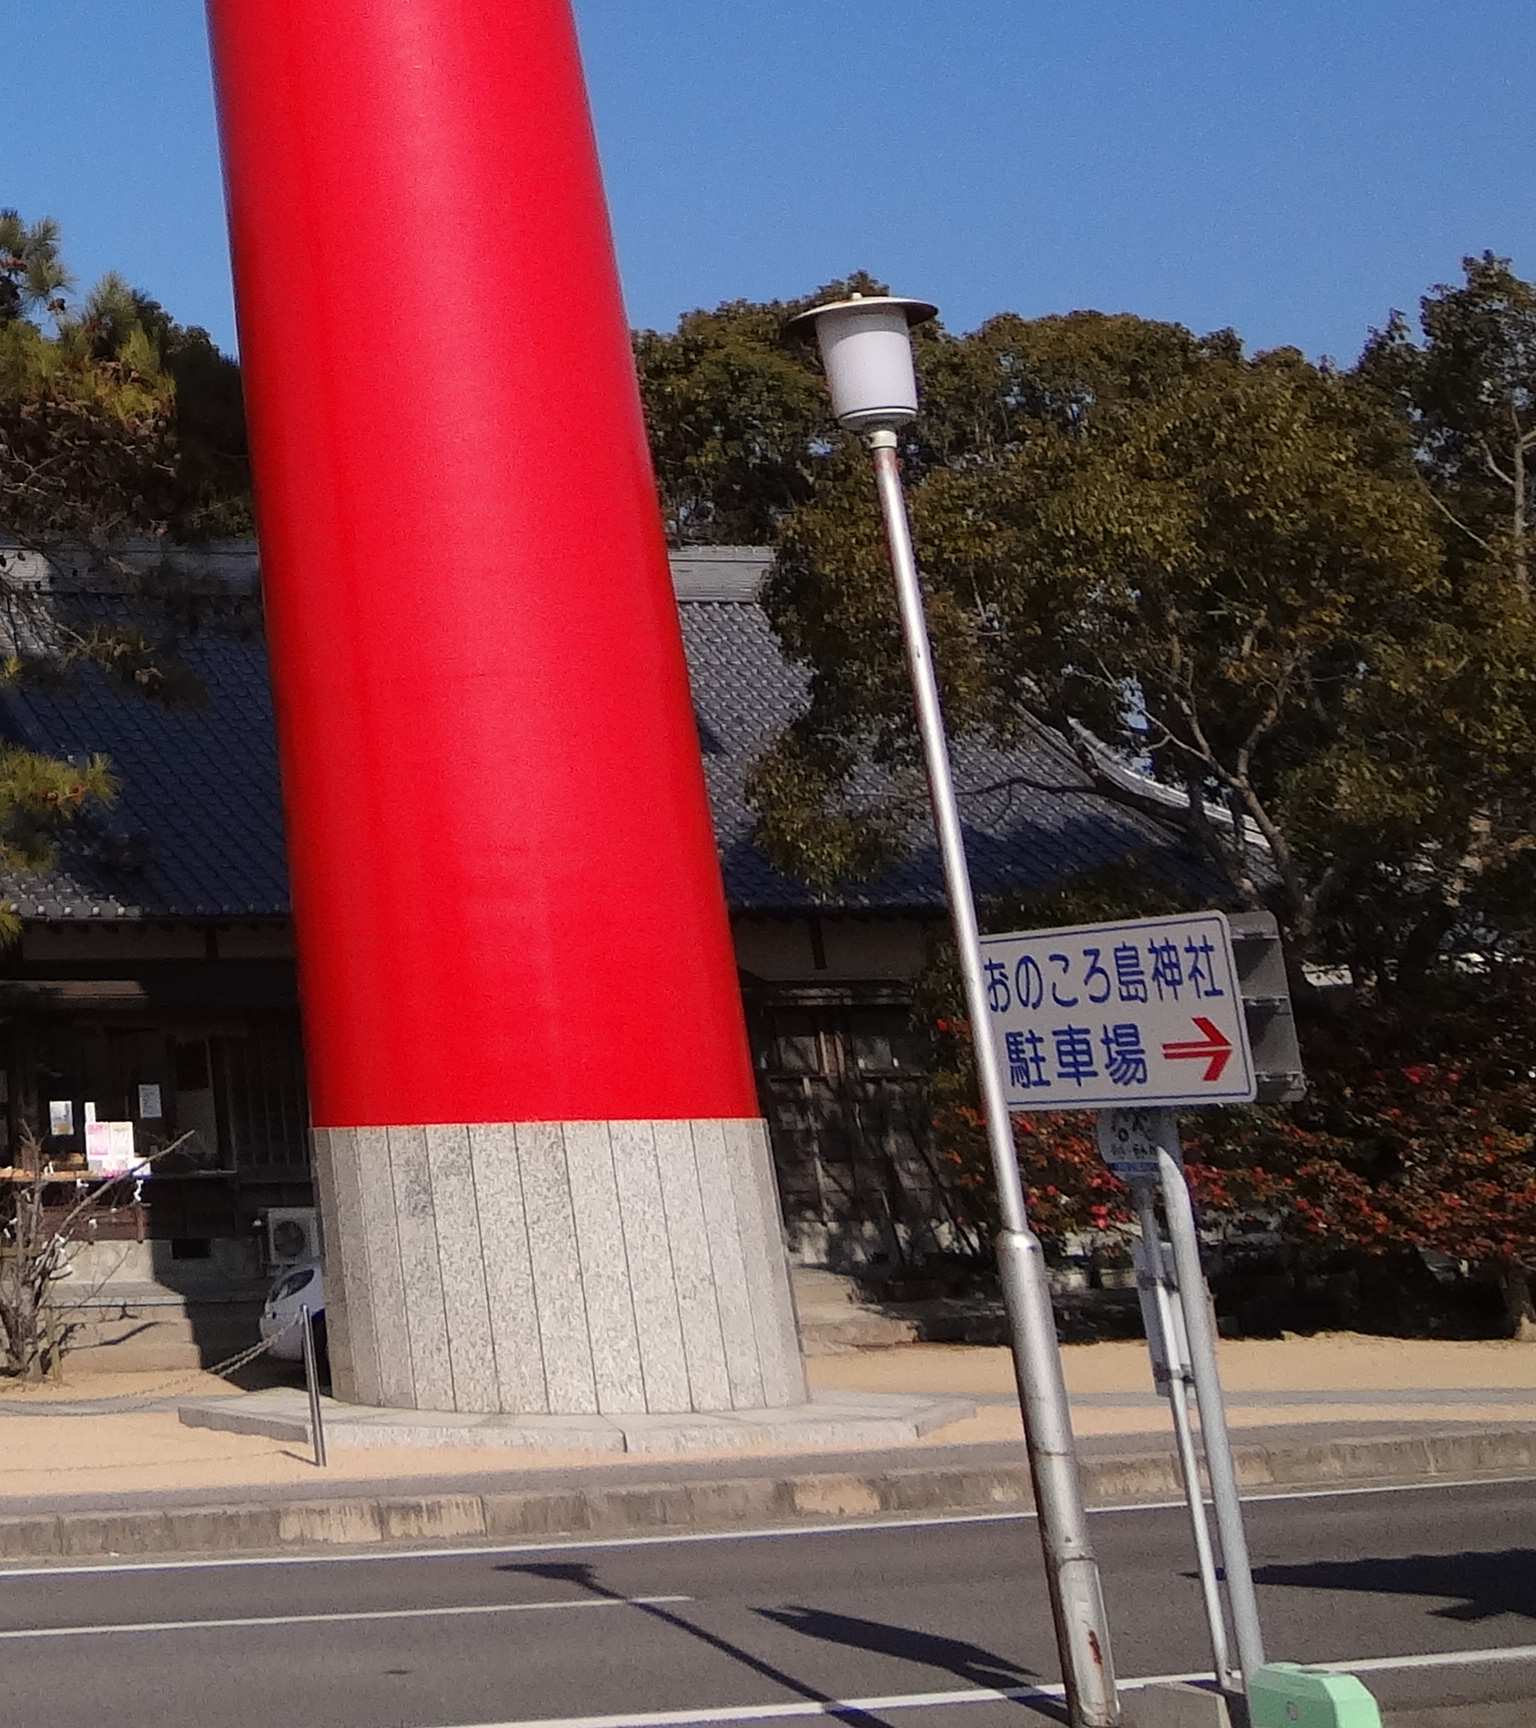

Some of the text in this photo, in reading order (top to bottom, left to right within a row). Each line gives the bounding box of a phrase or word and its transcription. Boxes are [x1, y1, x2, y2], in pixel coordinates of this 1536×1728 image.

[983, 934, 1225, 1013] おのころ島神社
[1005, 1023, 1148, 1089] 駐車場
